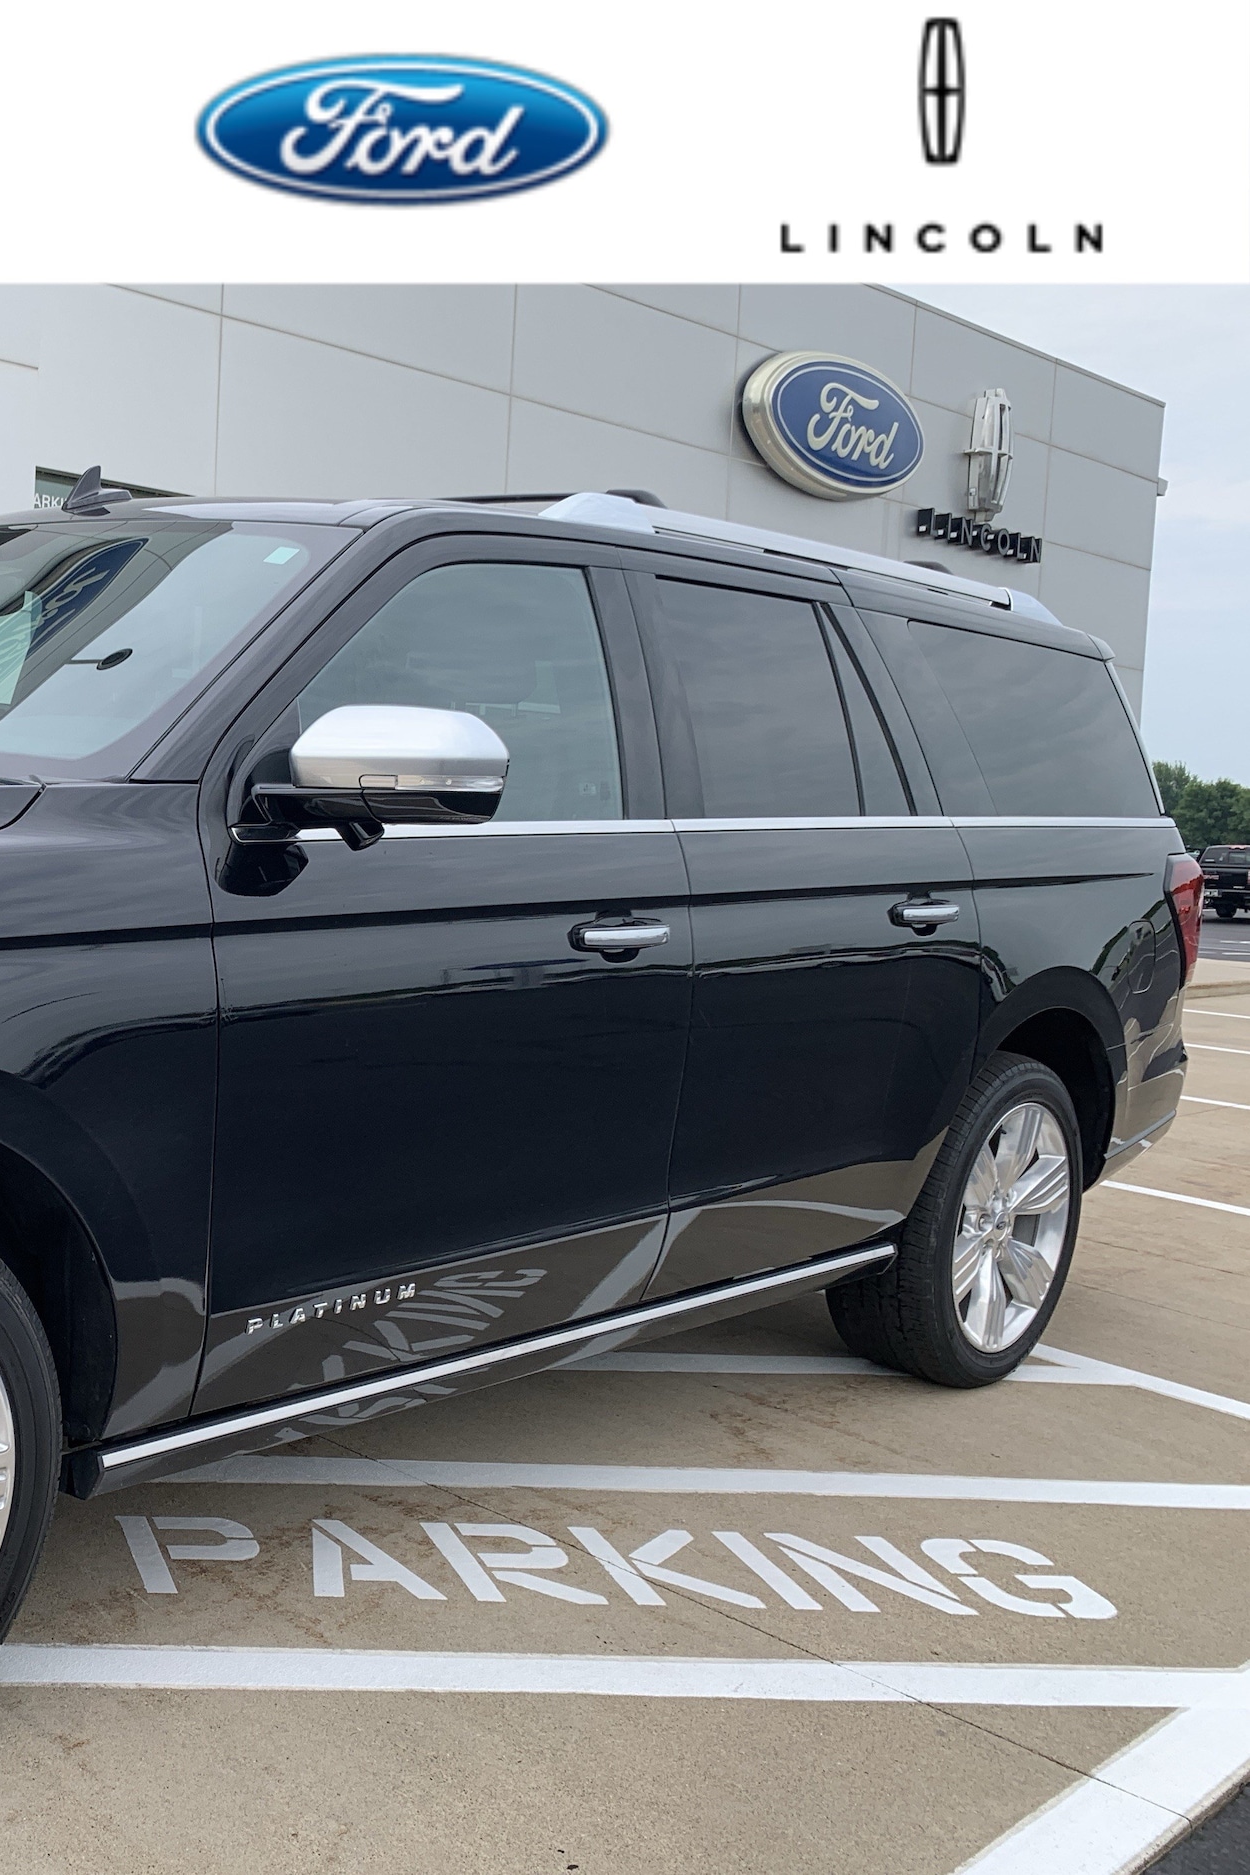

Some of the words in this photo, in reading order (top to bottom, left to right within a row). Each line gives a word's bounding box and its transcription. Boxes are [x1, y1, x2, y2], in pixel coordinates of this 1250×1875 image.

[806, 381, 899, 470] Ford
[917, 508, 1043, 563] LINCOLN
[245, 1283, 416, 1335] PLATINUM
[113, 1514, 1119, 1620] PARKING
